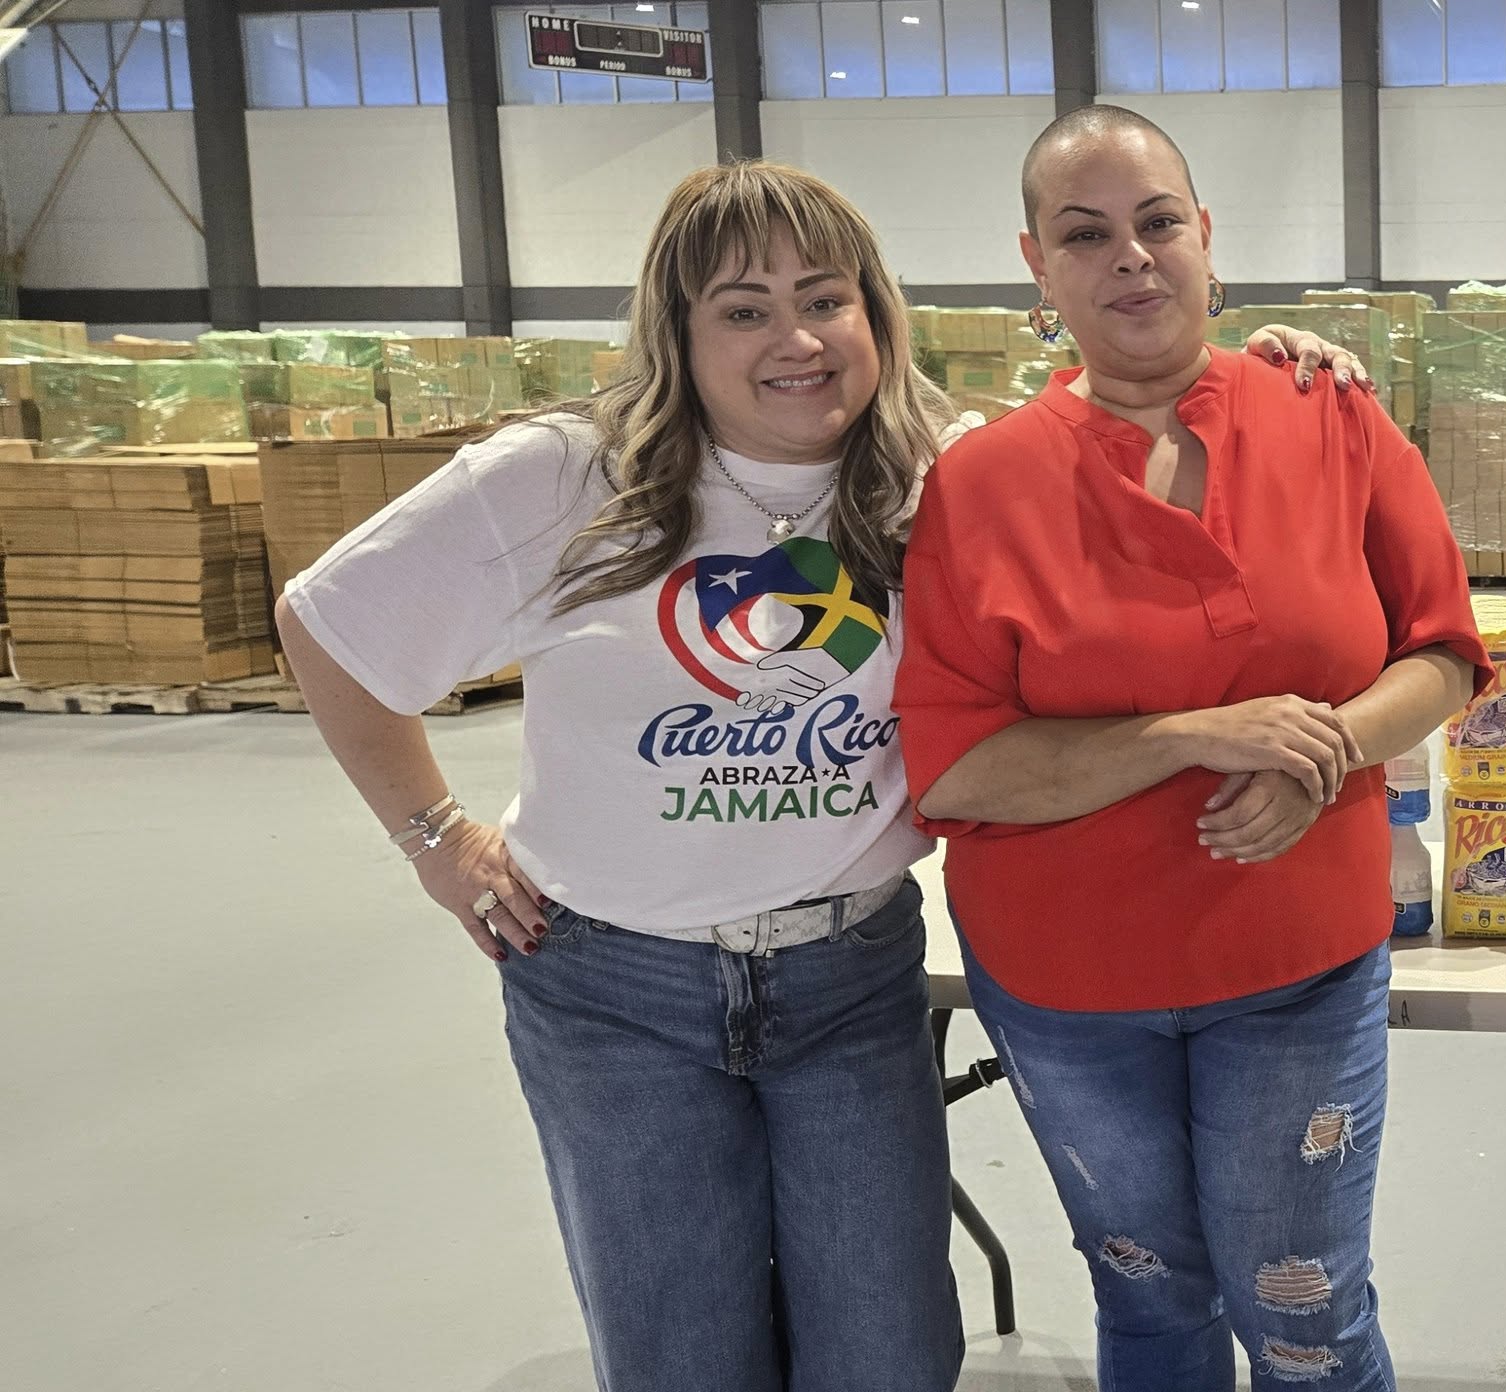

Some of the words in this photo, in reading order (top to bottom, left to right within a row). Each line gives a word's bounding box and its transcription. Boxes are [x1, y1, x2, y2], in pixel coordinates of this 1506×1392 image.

[532, 16, 570, 31] HOME
[663, 30, 702, 43] VISITOR
[548, 55, 576, 67] BONUS
[600, 60, 626, 71] PERIOD
[666, 66, 692, 77] BONUS
[637, 703, 795, 768] Puerto
[795, 694, 901, 769] Rico
[700, 765, 818, 785] ABRAZA
[660, 781, 879, 823] JAMAICA
